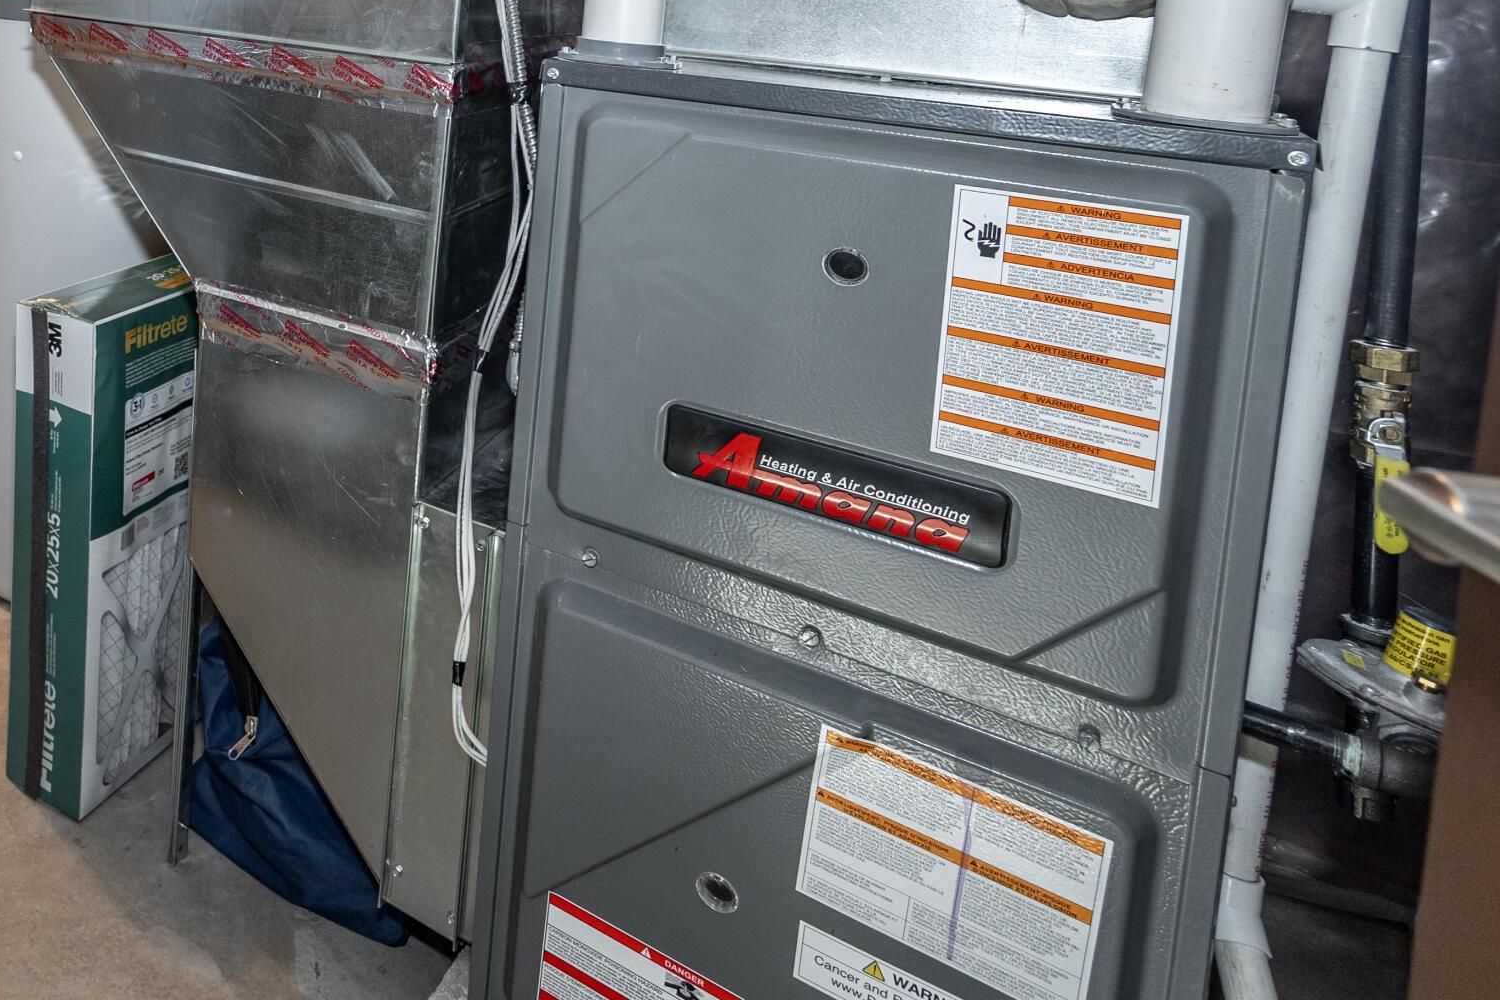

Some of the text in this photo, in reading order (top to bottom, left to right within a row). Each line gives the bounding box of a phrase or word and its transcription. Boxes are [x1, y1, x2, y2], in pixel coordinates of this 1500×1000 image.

[1071, 206, 1122, 220] WARNING
[1055, 234, 1145, 253] AVERTISSEMENT
[1061, 263, 1134, 281] ADVERTENCIA
[1044, 294, 1093, 309] WARNING
[49, 322, 62, 358] 3M
[125, 314, 188, 354] Filtrete
[1024, 342, 1110, 366] AVERTISSEMENT
[1036, 396, 1085, 412] WARNING
[1015, 430, 1103, 456] AVERTISSEMENT
[692, 432, 970, 552] Amana
[760, 455, 970, 525] Heating & Air Conditioning
[1426, 647, 1447, 658] GAS
[604, 958, 637, 980] POISONING
[638, 978, 663, 994] HAZARD
[664, 959, 705, 988] DANGER
[814, 955, 888, 999] Cancer and
